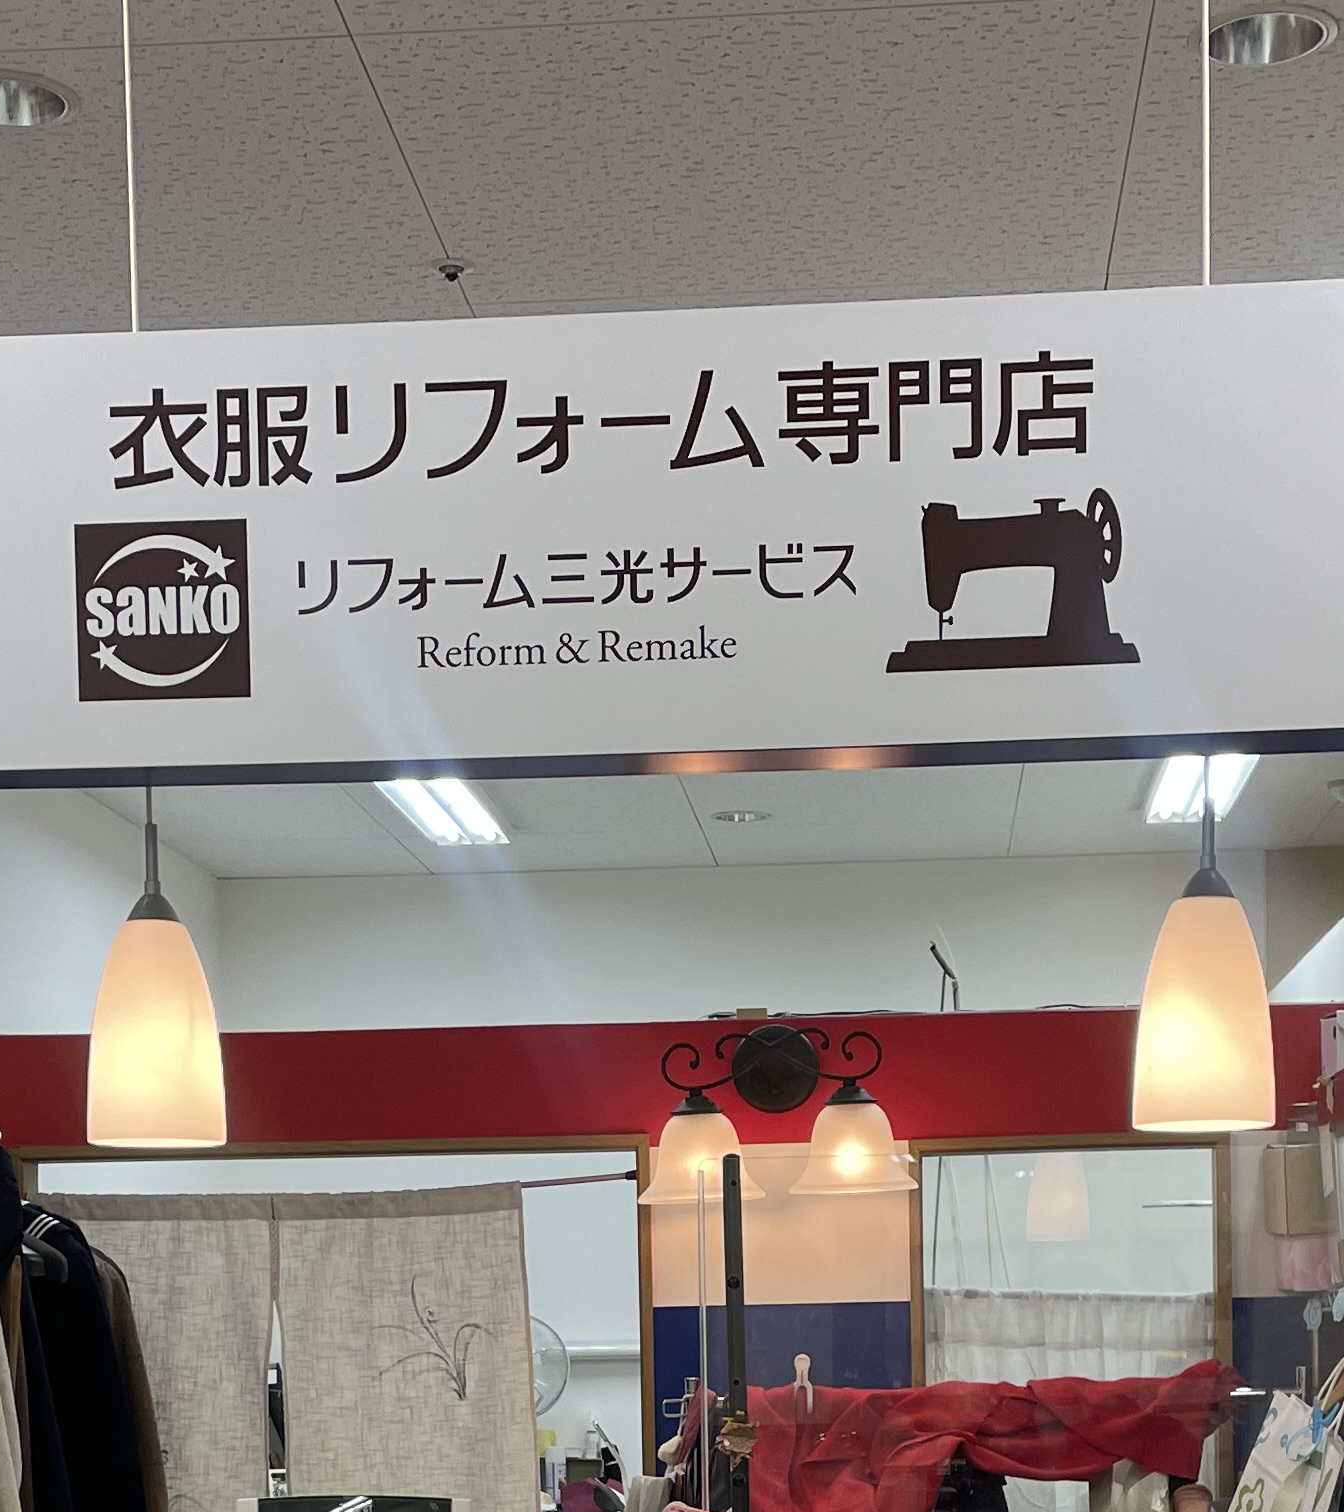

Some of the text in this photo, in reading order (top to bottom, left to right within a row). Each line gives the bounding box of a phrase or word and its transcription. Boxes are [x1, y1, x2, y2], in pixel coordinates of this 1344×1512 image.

[108, 351, 1095, 490] 衣服リフォーム専門店
[298, 543, 856, 616] リフォーム三光サービス
[417, 625, 738, 669] Reform & Remake
